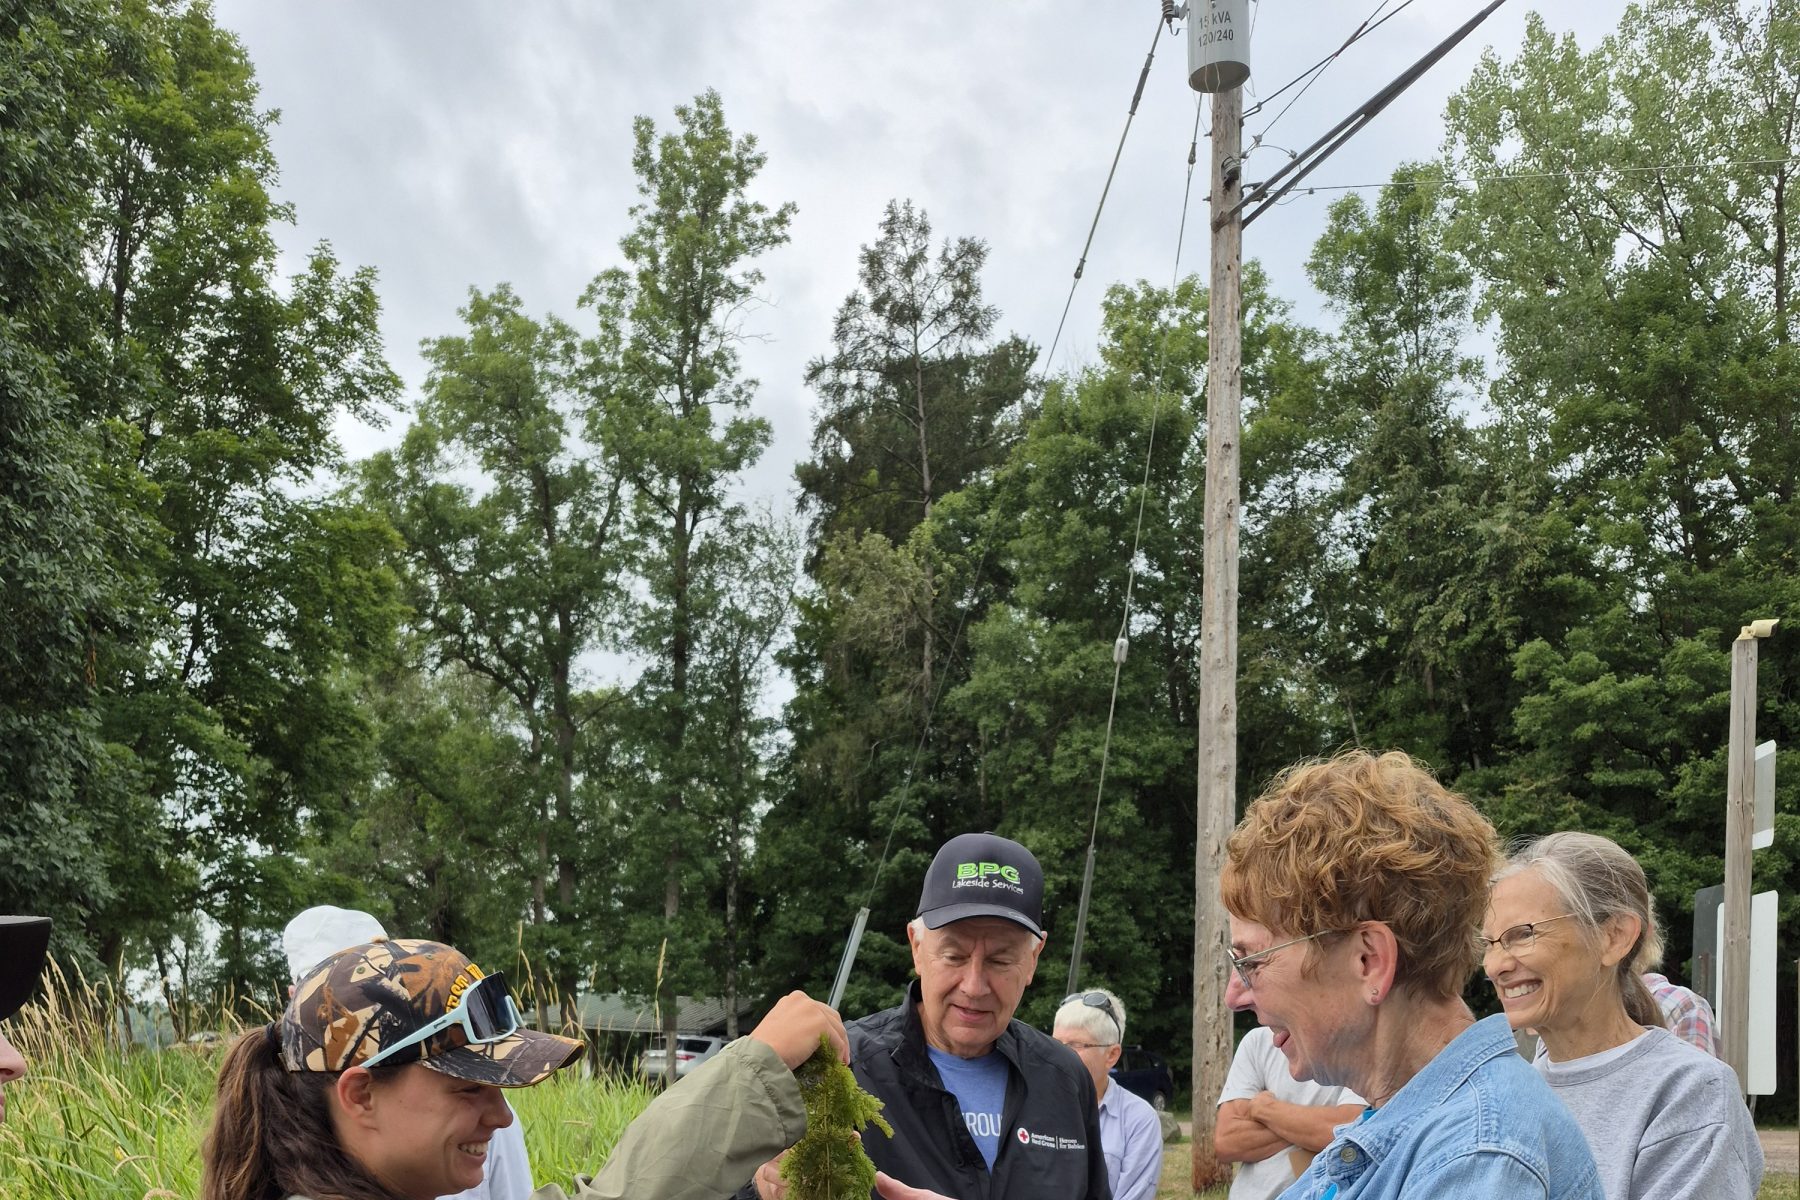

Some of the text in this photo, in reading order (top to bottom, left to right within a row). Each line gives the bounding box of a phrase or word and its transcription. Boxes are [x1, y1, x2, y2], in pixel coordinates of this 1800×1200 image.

[1199, 11, 1232, 30] 15 kVA
[1198, 29, 1234, 47] 120/240
[956, 862, 1021, 885] BPG
[952, 878, 1024, 895] Lakeside Services
[962, 1112, 1003, 1137] ROU
